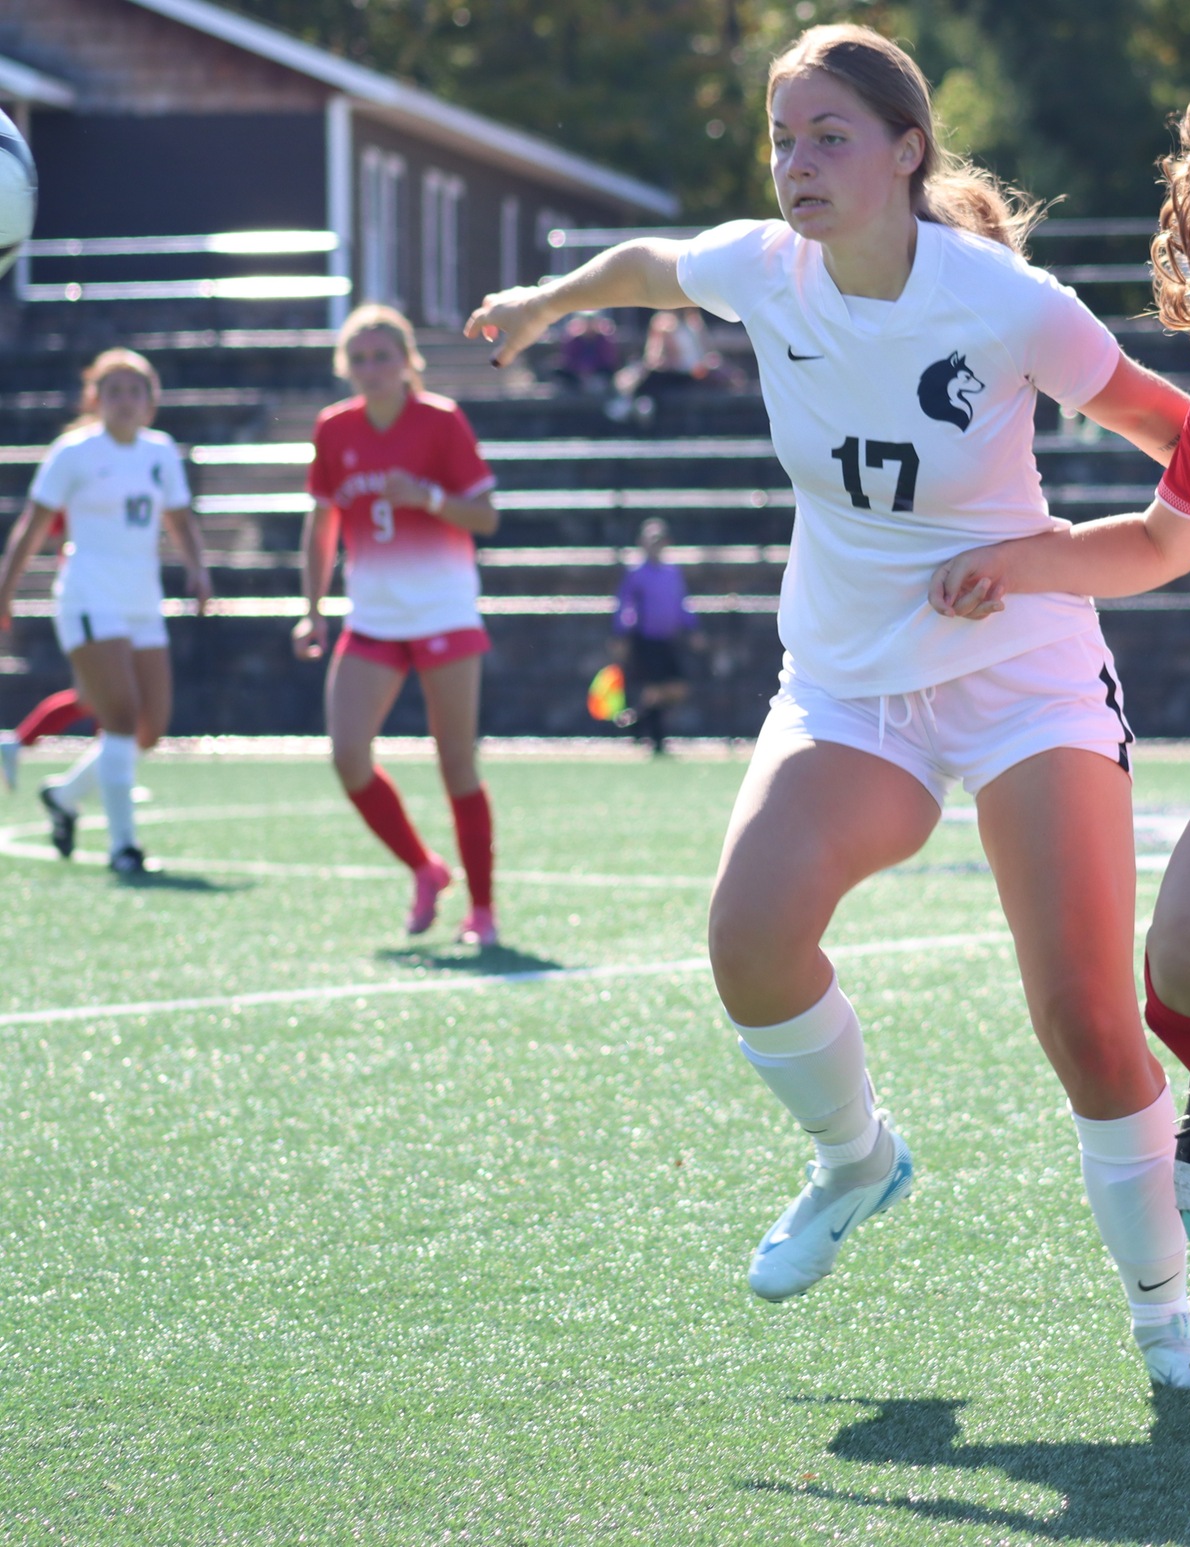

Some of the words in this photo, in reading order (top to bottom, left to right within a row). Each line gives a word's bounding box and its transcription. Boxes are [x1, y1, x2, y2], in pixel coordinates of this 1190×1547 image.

[831, 435, 920, 512] 17
[125, 494, 153, 528] 10
[371, 499, 395, 542] 9
